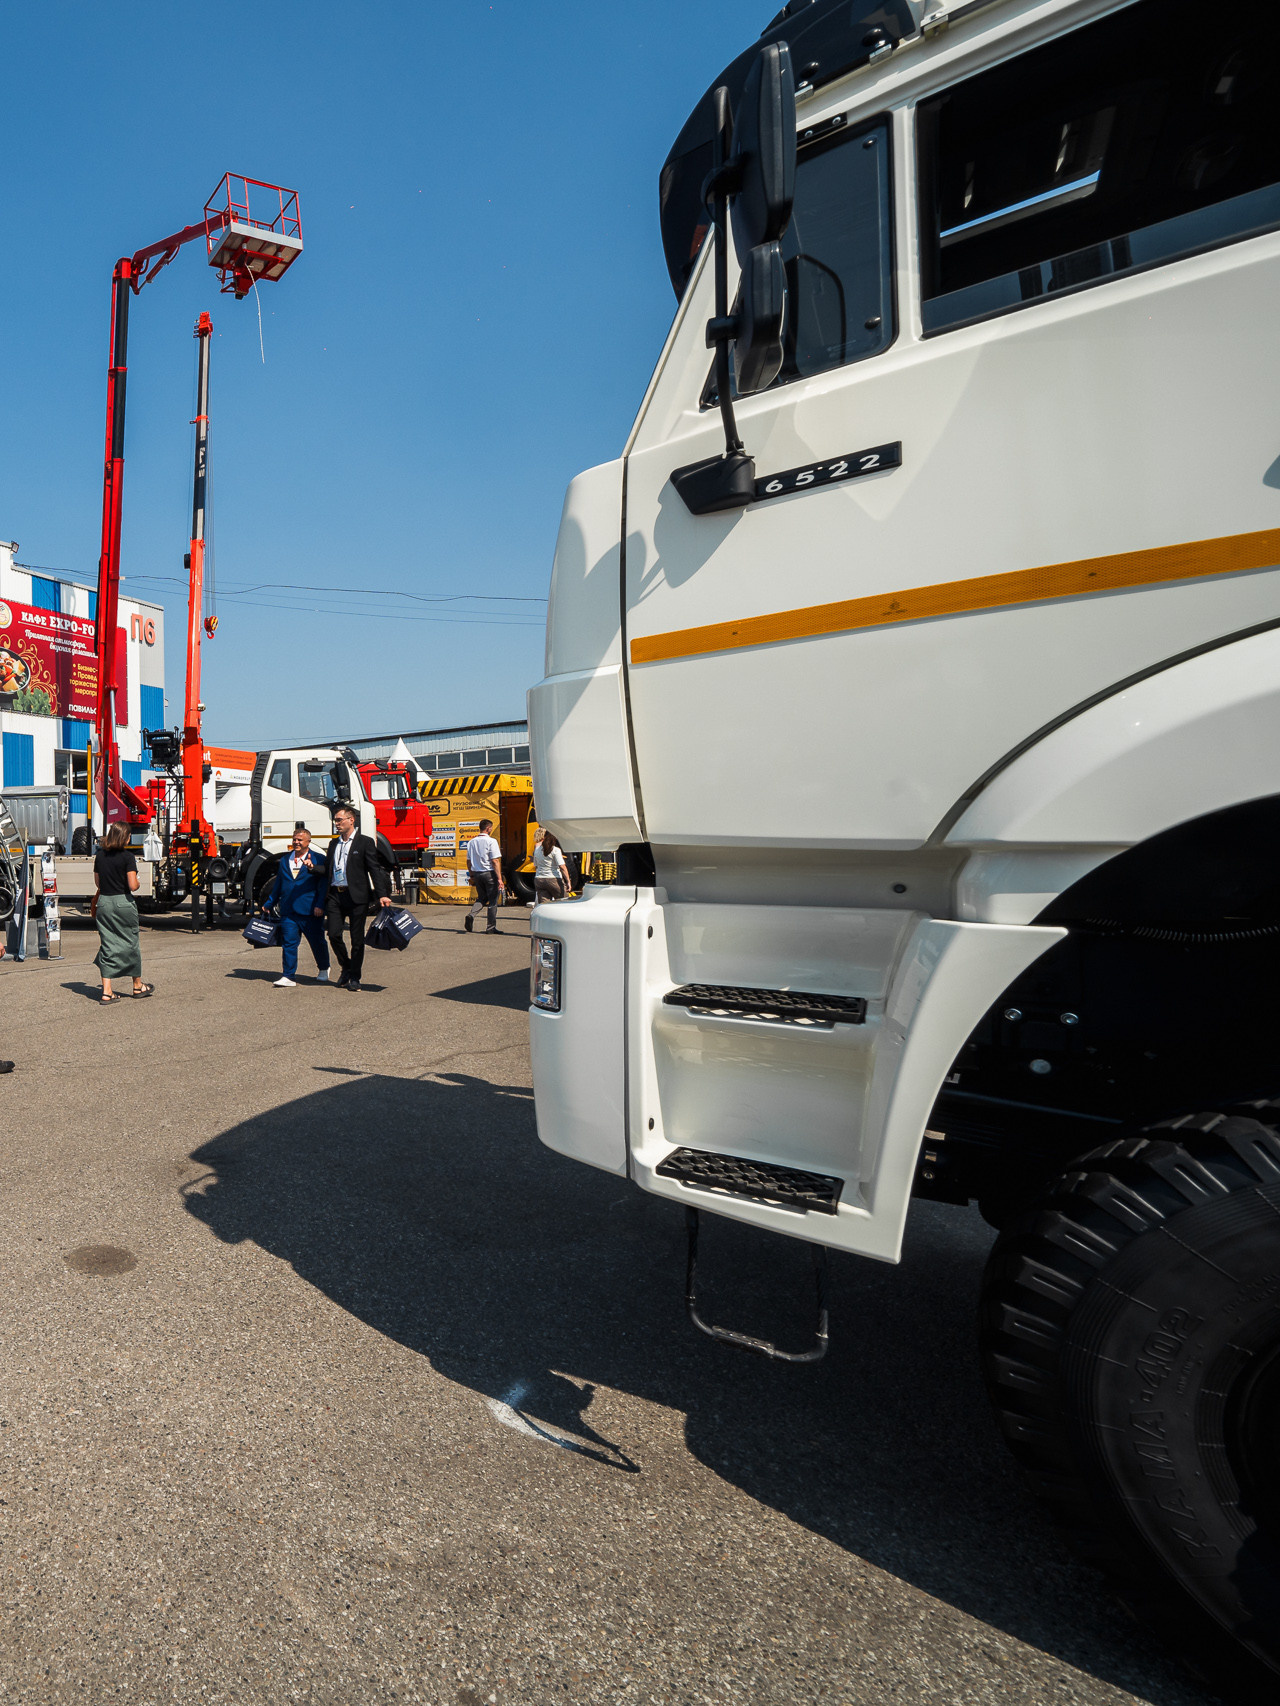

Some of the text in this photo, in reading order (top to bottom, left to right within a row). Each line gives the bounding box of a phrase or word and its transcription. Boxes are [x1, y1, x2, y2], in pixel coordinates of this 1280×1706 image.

[765, 454, 880, 493] 6522
[21, 611, 95, 637] КАФЕ EXPO-FO
[130, 612, 156, 644] П6
[69, 679, 98, 689] торжестве
